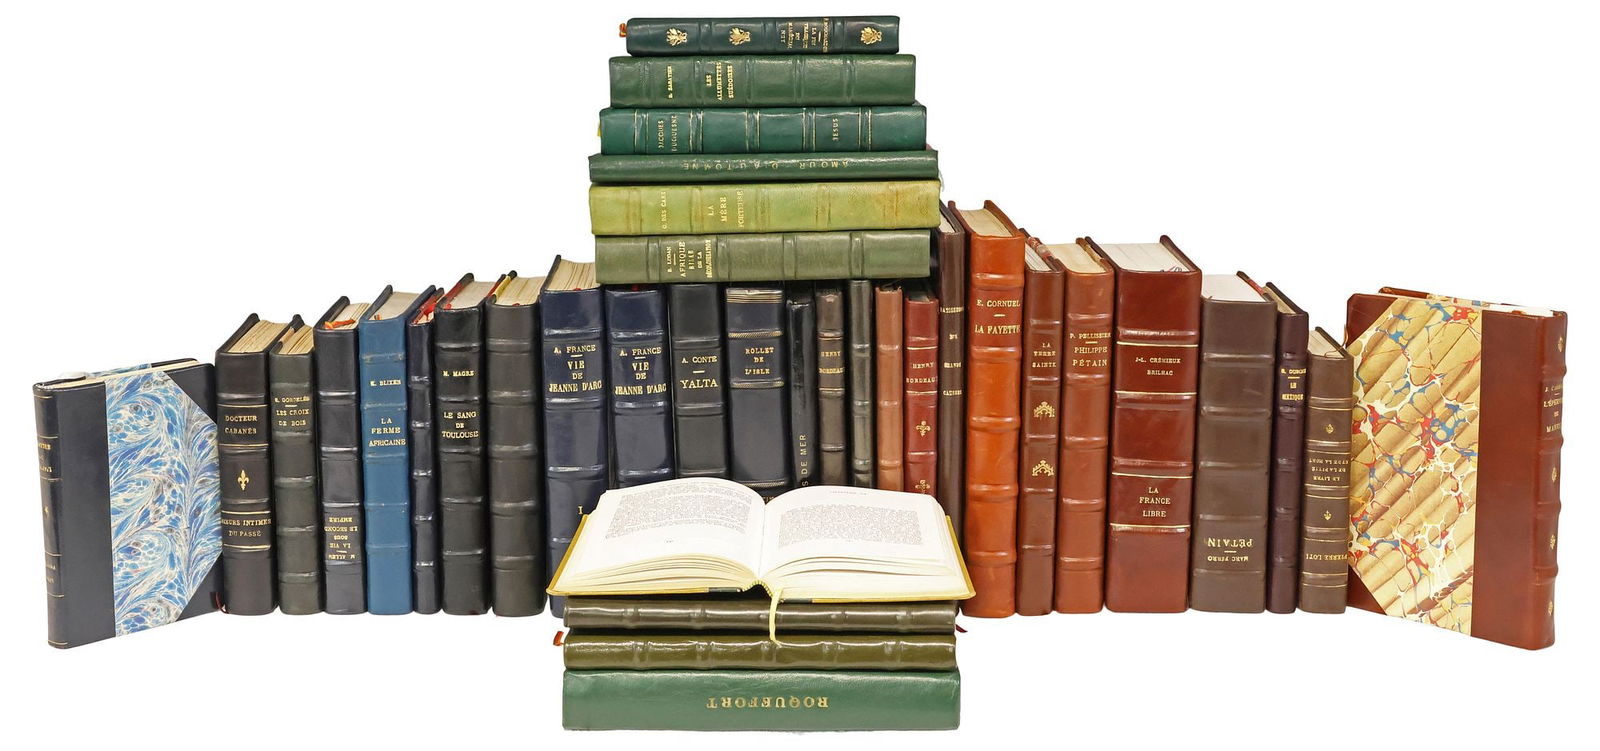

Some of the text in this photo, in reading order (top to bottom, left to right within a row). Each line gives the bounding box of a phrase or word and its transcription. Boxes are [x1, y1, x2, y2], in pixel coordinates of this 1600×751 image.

[798, 160, 848, 169] AMOUR
[708, 205, 714, 216] LA
[678, 241, 686, 278] AFRIQUE
[976, 299, 984, 307] E.
[974, 324, 1021, 335] LA FAYETTE
[566, 344, 596, 353] FRANCE
[632, 347, 662, 356] FRANCE
[1074, 346, 1108, 354] PHILIPPE
[567, 360, 585, 370] VIE
[632, 361, 650, 372] VIE
[912, 361, 934, 369] HENRY
[1072, 358, 1108, 367] PÉTAIN
[572, 372, 583, 380] DE
[549, 380, 602, 393] JEANNE D'ARC
[681, 379, 718, 389] YALTA
[614, 383, 666, 395] JEANNE D'ARC
[289, 408, 310, 416] CROIX
[443, 411, 477, 419] LE SANG
[371, 426, 401, 435] FERME
[441, 431, 479, 439] TOULOUSE
[368, 439, 406, 447] AFRICAINE
[799, 434, 807, 456] MER
[800, 461, 808, 475] DE
[1139, 496, 1171, 505] FRANCE
[1142, 509, 1167, 518] LIBRE
[1207, 537, 1253, 549] PÉTAIN
[706, 696, 828, 709] ROQUEFORT
